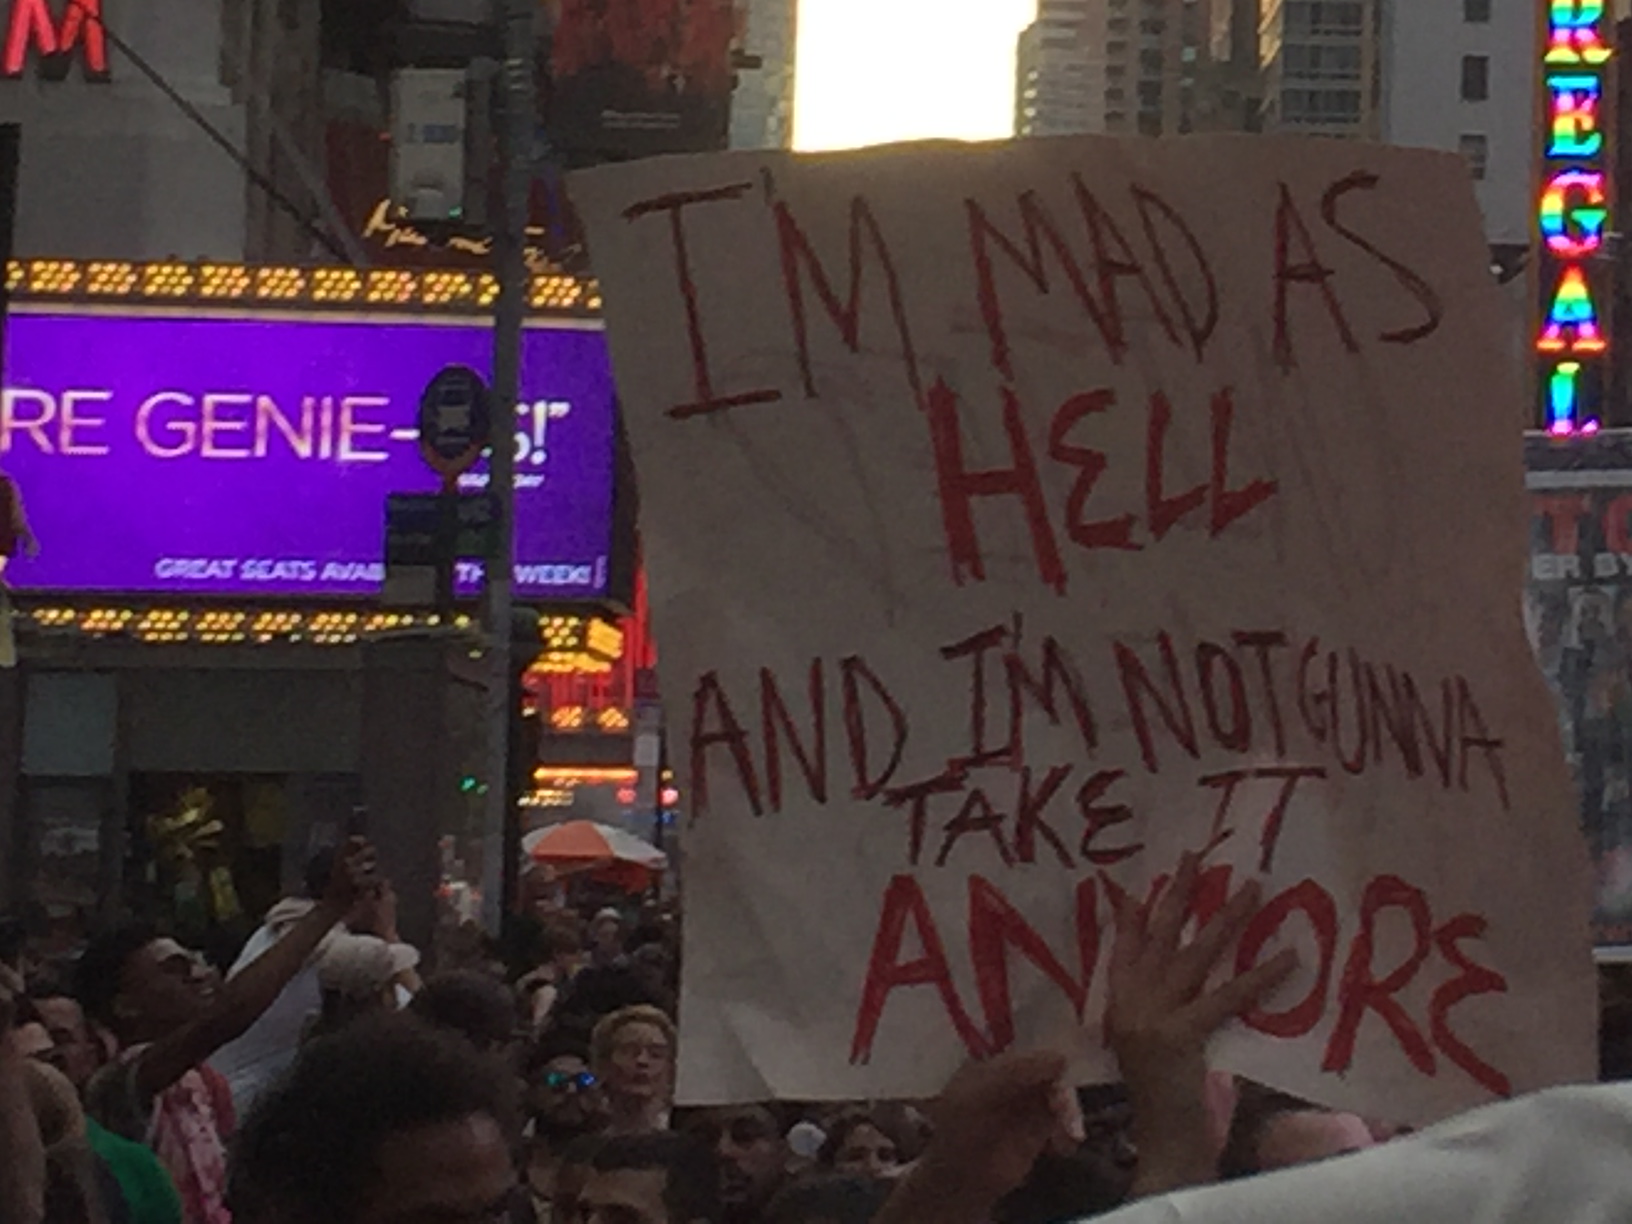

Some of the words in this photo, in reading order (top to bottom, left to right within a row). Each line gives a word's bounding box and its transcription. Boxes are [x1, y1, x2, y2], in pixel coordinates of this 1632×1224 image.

[623, 168, 928, 417] I'M
[965, 173, 1218, 381] MAD
[1272, 168, 1443, 378] AS
[154, 557, 237, 580] GREAT
[239, 558, 317, 581] SEATS
[928, 378, 1280, 596] HELL
[690, 654, 907, 815] AND
[941, 613, 1097, 772] I'M
[1113, 628, 1288, 773] NOT
[1296, 644, 1510, 810] GUNNA
[883, 762, 1145, 870] TAKE
[1199, 761, 1327, 872] IT
